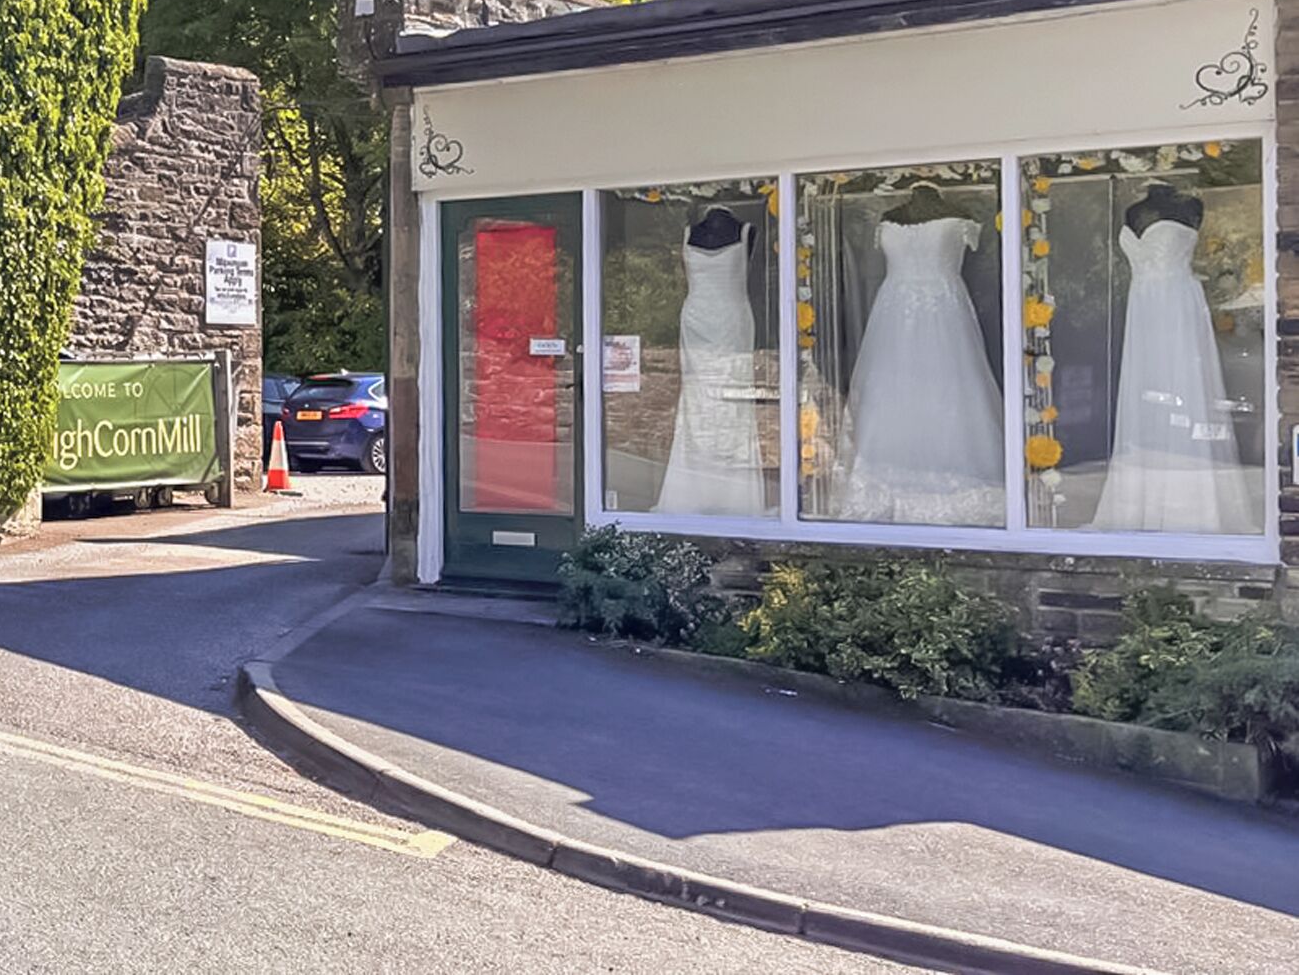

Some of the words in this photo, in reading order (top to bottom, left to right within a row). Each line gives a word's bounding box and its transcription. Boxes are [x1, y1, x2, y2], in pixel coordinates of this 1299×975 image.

[62, 383, 116, 399] LCOME
[123, 382, 144, 398] TO
[53, 414, 202, 470] ighCornMill
